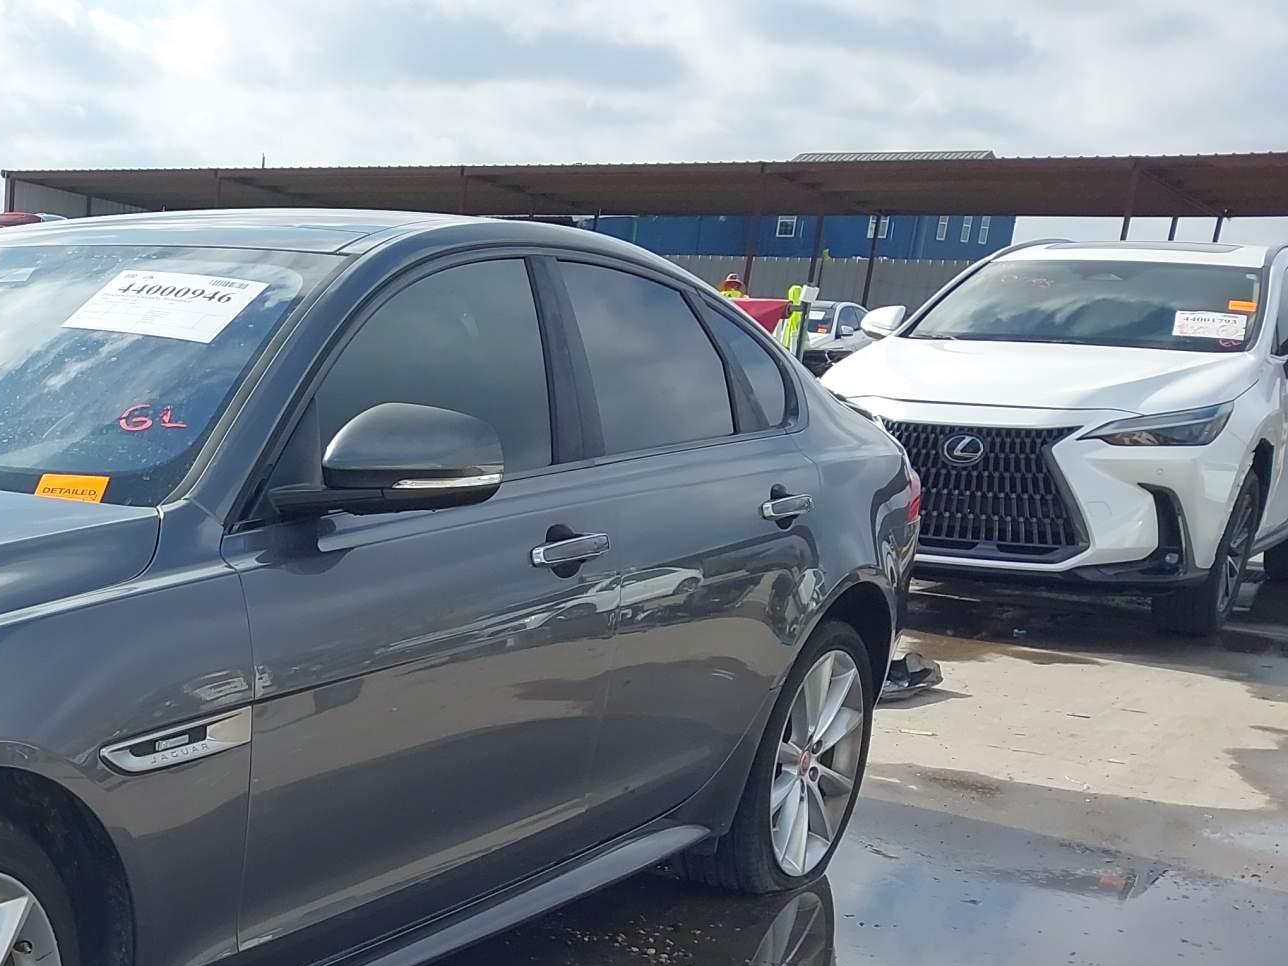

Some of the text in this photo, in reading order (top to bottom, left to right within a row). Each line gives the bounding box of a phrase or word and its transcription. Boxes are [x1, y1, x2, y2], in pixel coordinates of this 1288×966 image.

[118, 281, 239, 304] 44000946
[42, 486, 97, 497] DETAILED
[151, 742, 209, 765] JAGUAR
